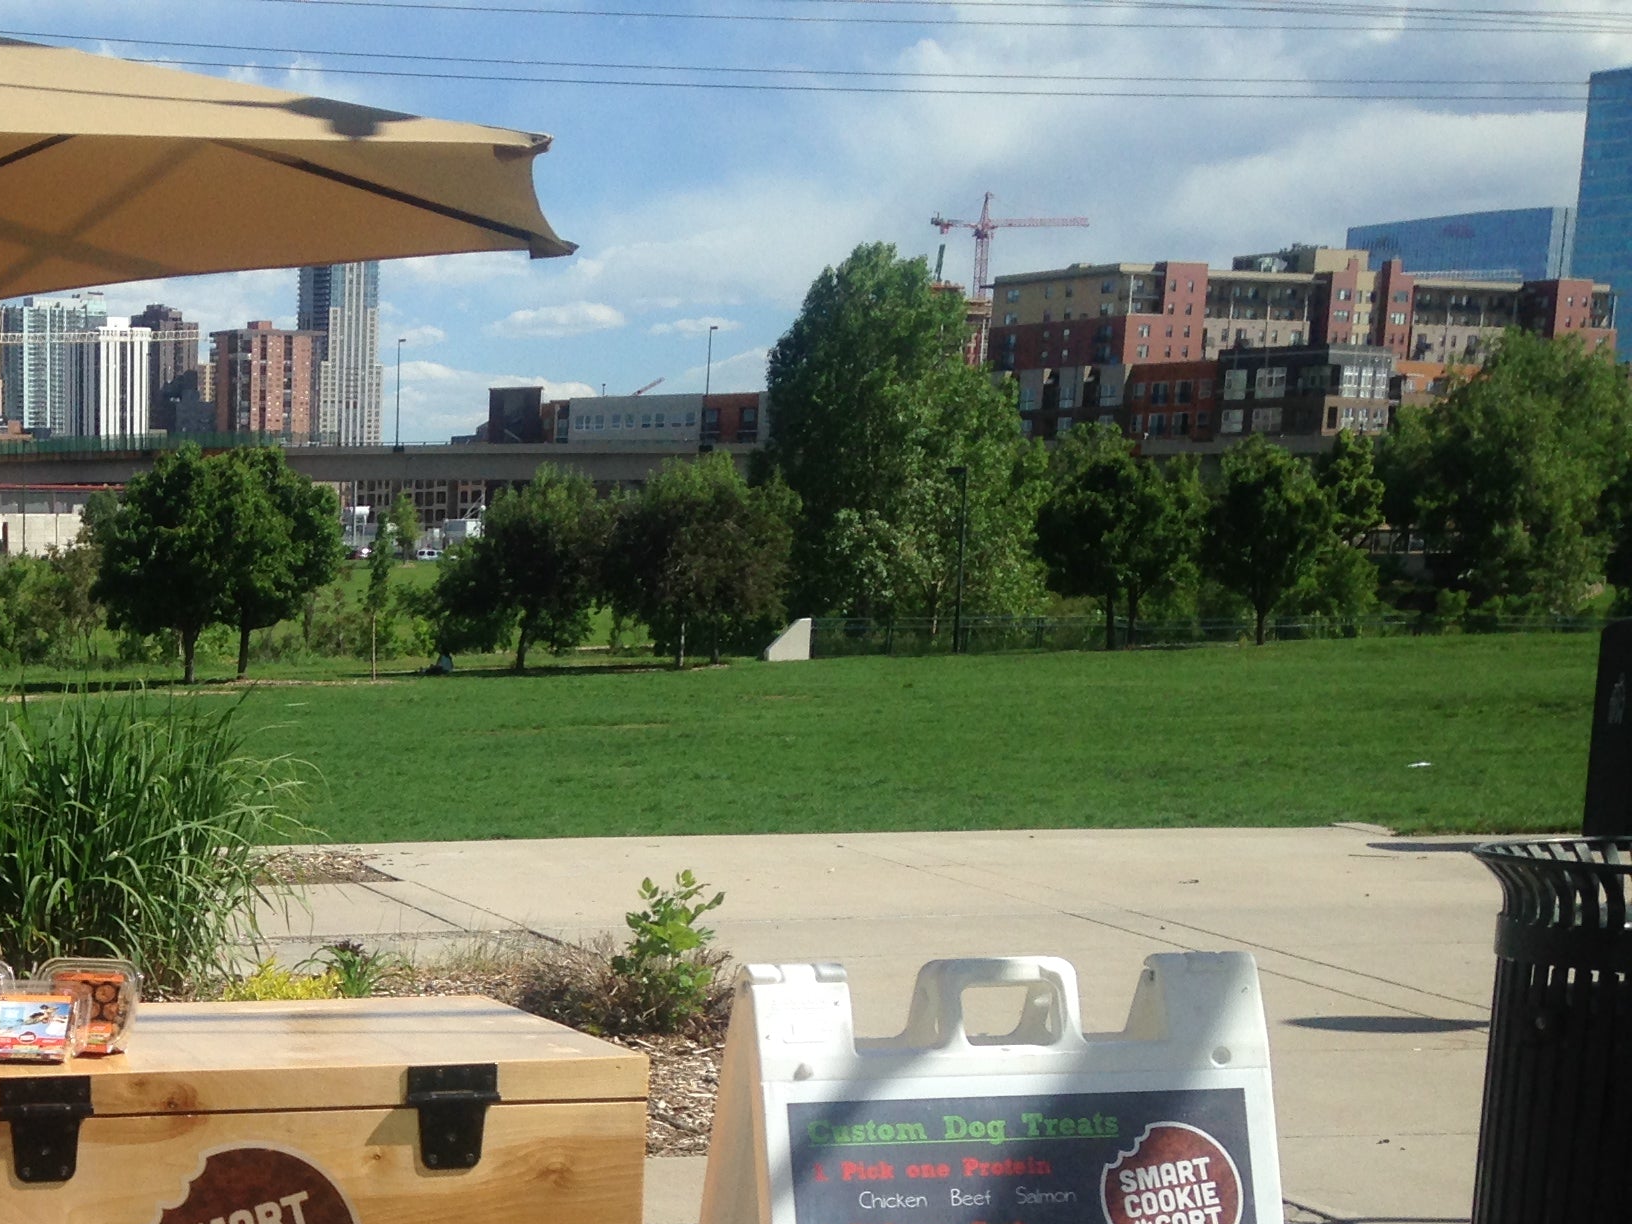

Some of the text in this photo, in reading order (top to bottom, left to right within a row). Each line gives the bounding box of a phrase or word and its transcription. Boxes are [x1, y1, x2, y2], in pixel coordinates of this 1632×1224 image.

[808, 1111, 1118, 1145] Custom Dog Treats
[841, 1160, 894, 1181] Pick
[906, 1162, 951, 1179] one
[962, 1156, 1052, 1177] Protein
[1119, 1156, 1210, 1193] SMART
[859, 1186, 1076, 1209] Chicken Beef Salmon
[1124, 1181, 1220, 1218] COOKIE
